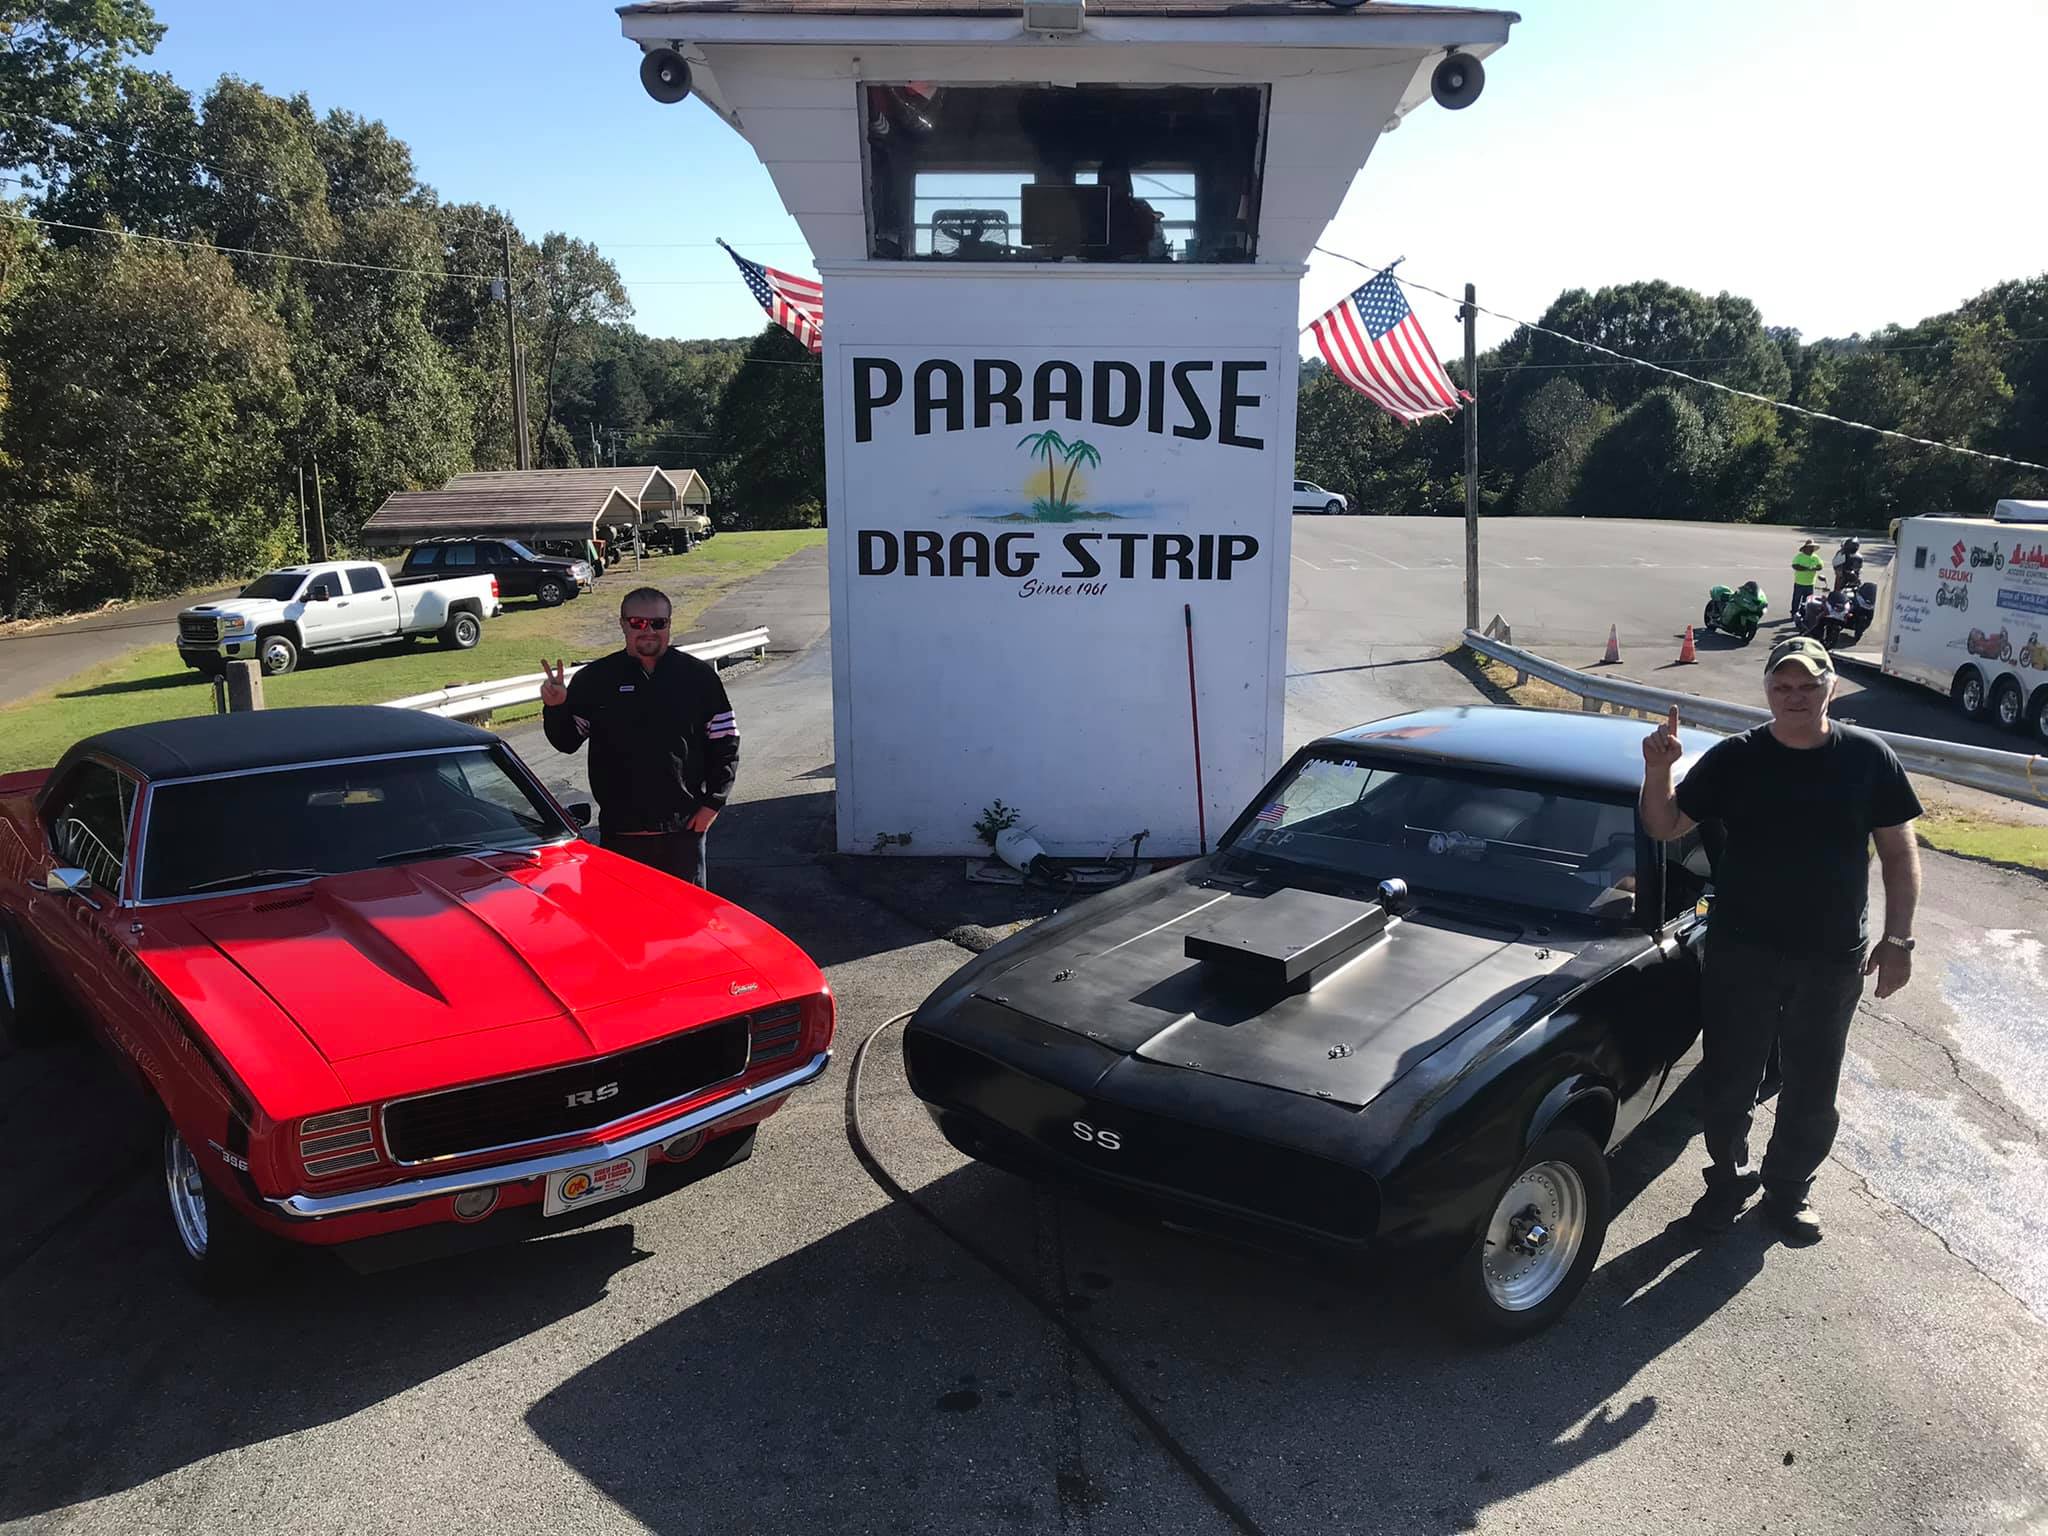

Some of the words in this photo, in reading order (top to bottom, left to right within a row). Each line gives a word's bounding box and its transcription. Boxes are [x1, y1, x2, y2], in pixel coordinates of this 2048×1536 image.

[852, 356, 1267, 450] PARADISE
[858, 529, 1040, 578] DRAG
[1061, 532, 1259, 580] STRIP
[1938, 567, 1973, 583] SUZUKI
[1018, 578, 1073, 598] Since
[1077, 582, 1107, 596] 1961
[565, 1082, 619, 1108] RS
[1073, 1120, 1121, 1150] SS
[222, 1151, 249, 1172] 396
[567, 1177, 588, 1196] OK
